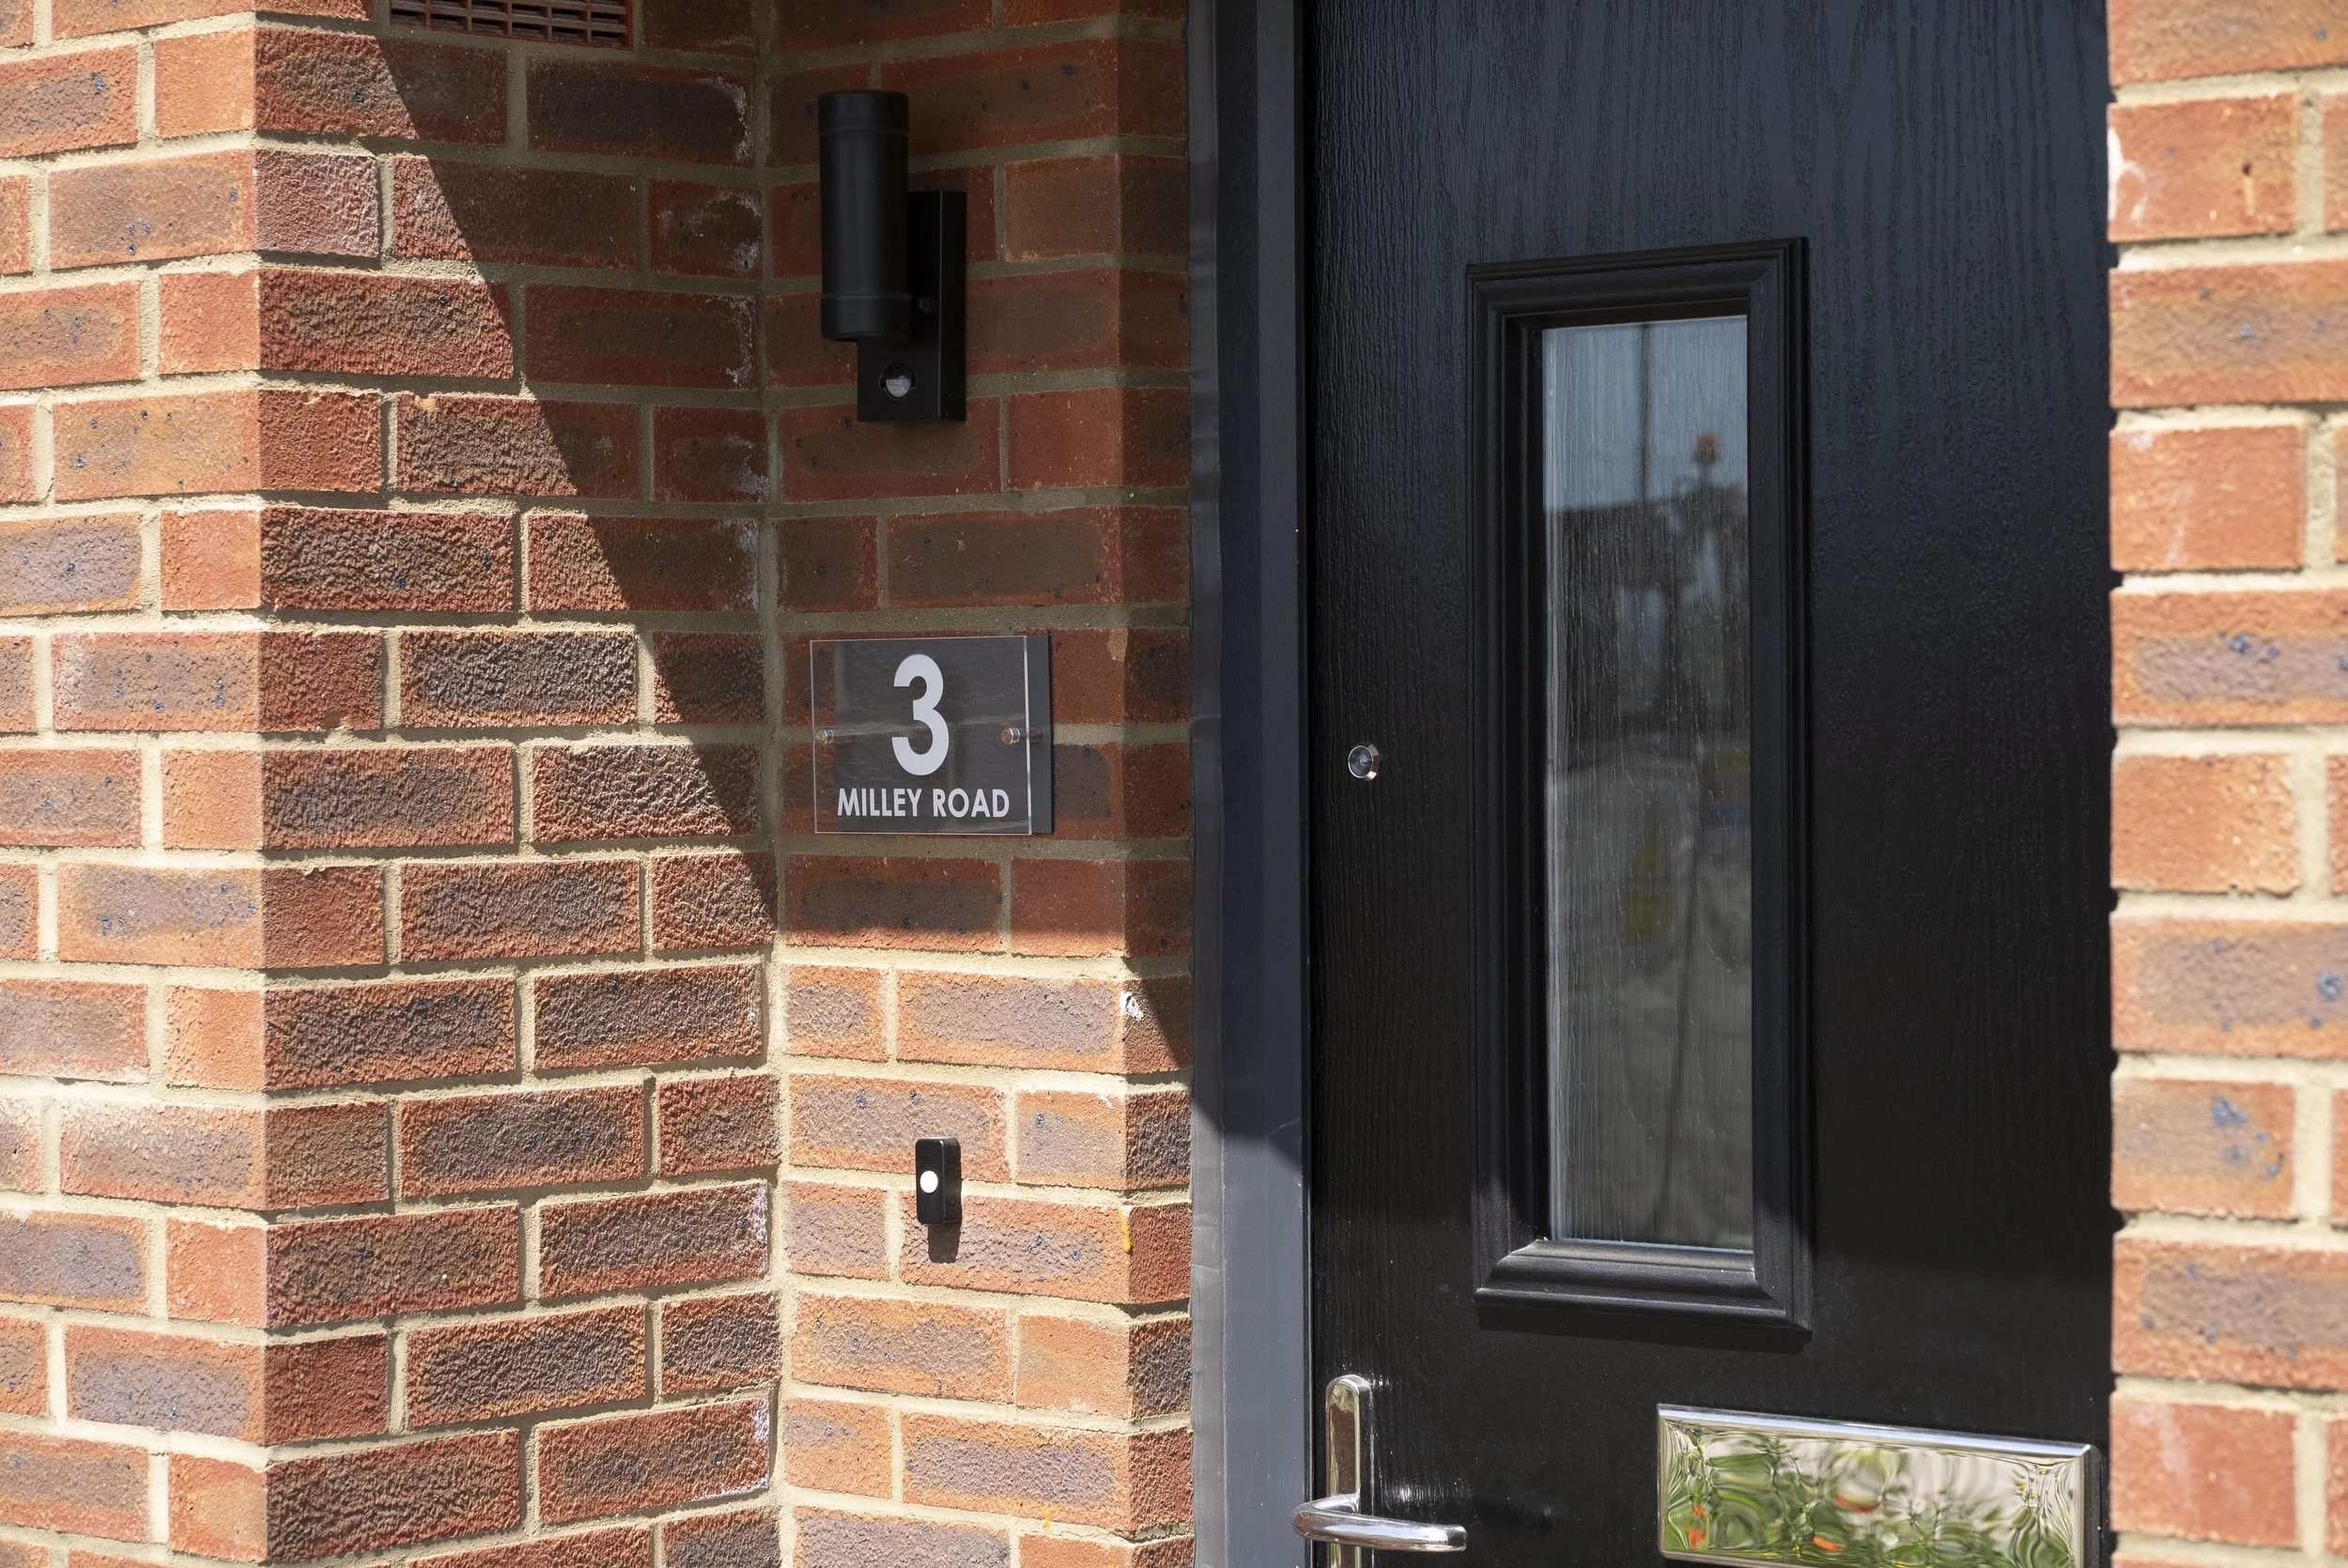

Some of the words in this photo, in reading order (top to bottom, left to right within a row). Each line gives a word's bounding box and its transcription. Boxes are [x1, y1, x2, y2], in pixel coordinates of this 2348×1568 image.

[891, 653, 950, 776] 3
[837, 788, 922, 817] MILLEY
[933, 788, 1010, 818] ROAD
